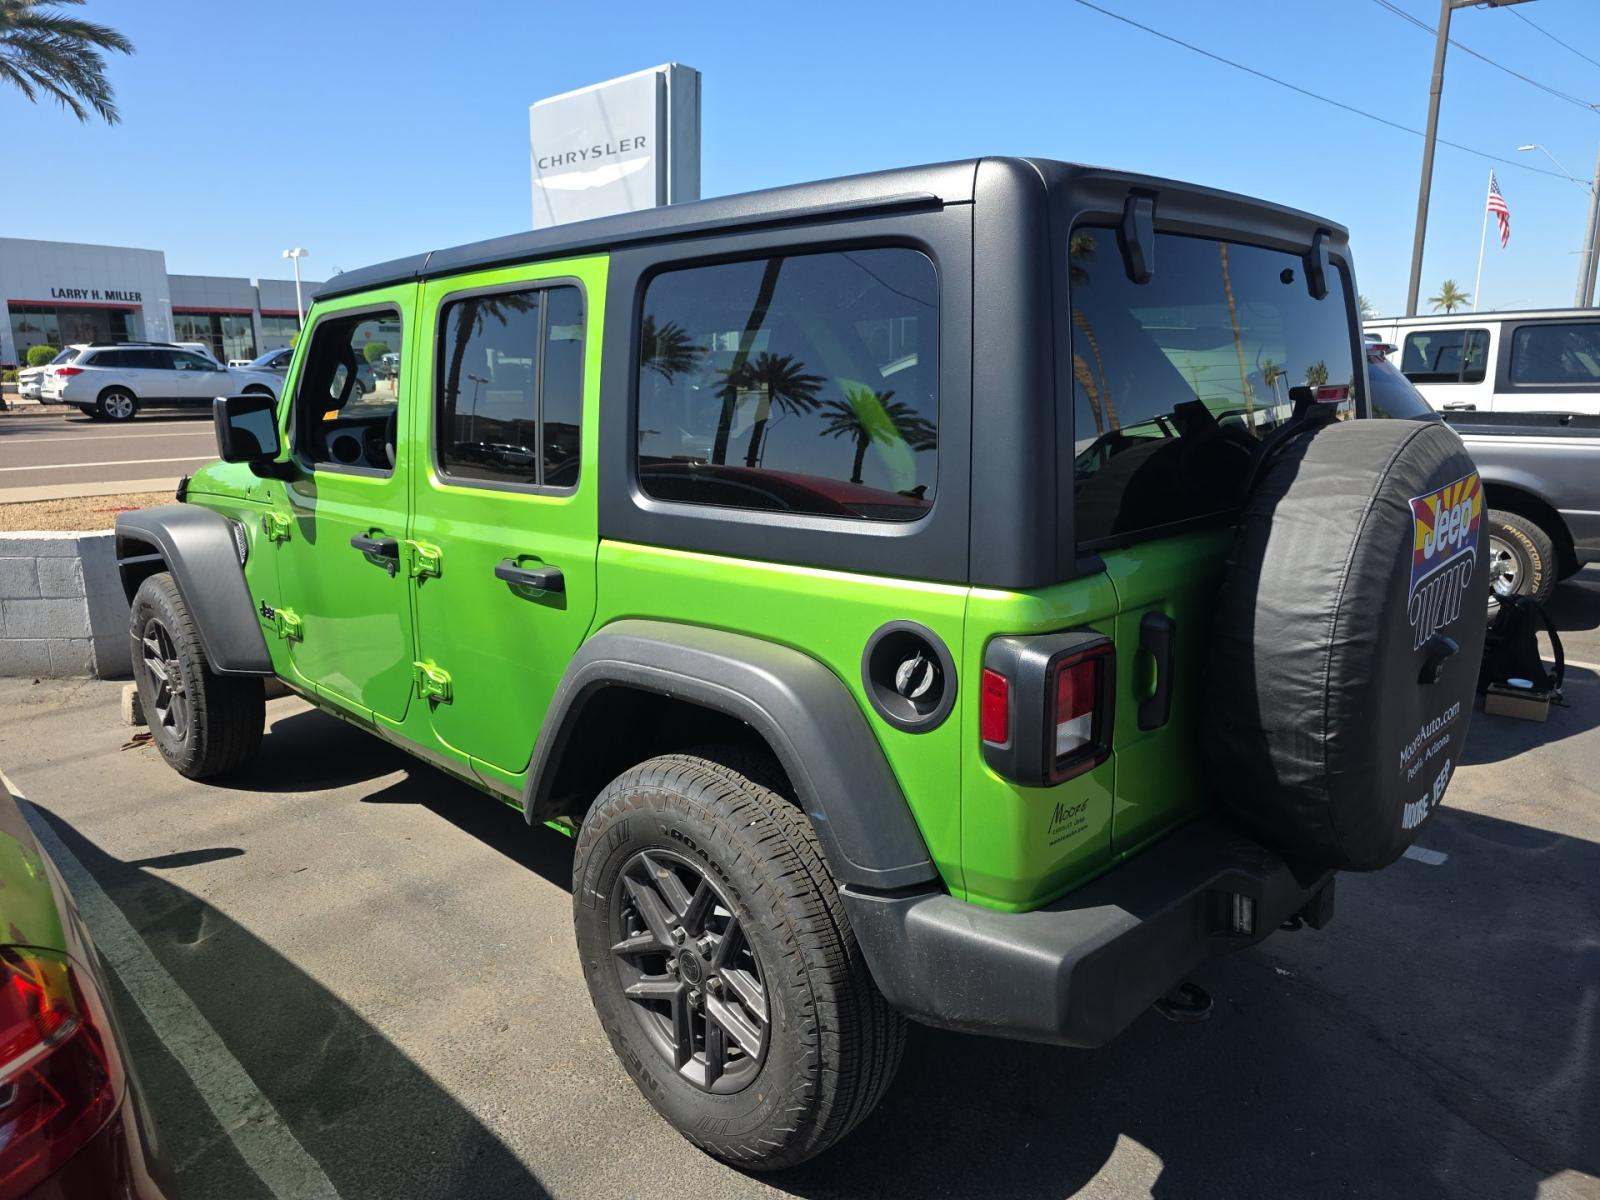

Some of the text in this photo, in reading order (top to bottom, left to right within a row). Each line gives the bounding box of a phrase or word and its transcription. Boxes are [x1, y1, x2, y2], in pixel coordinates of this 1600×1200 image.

[538, 136, 647, 170] CHRYSLER
[51, 287, 142, 302] LARRY H. MILLER
[1423, 497, 1472, 560] Jeep
[1400, 701, 1460, 768] MooreAuto.com
[1431, 757, 1450, 807] JEEP
